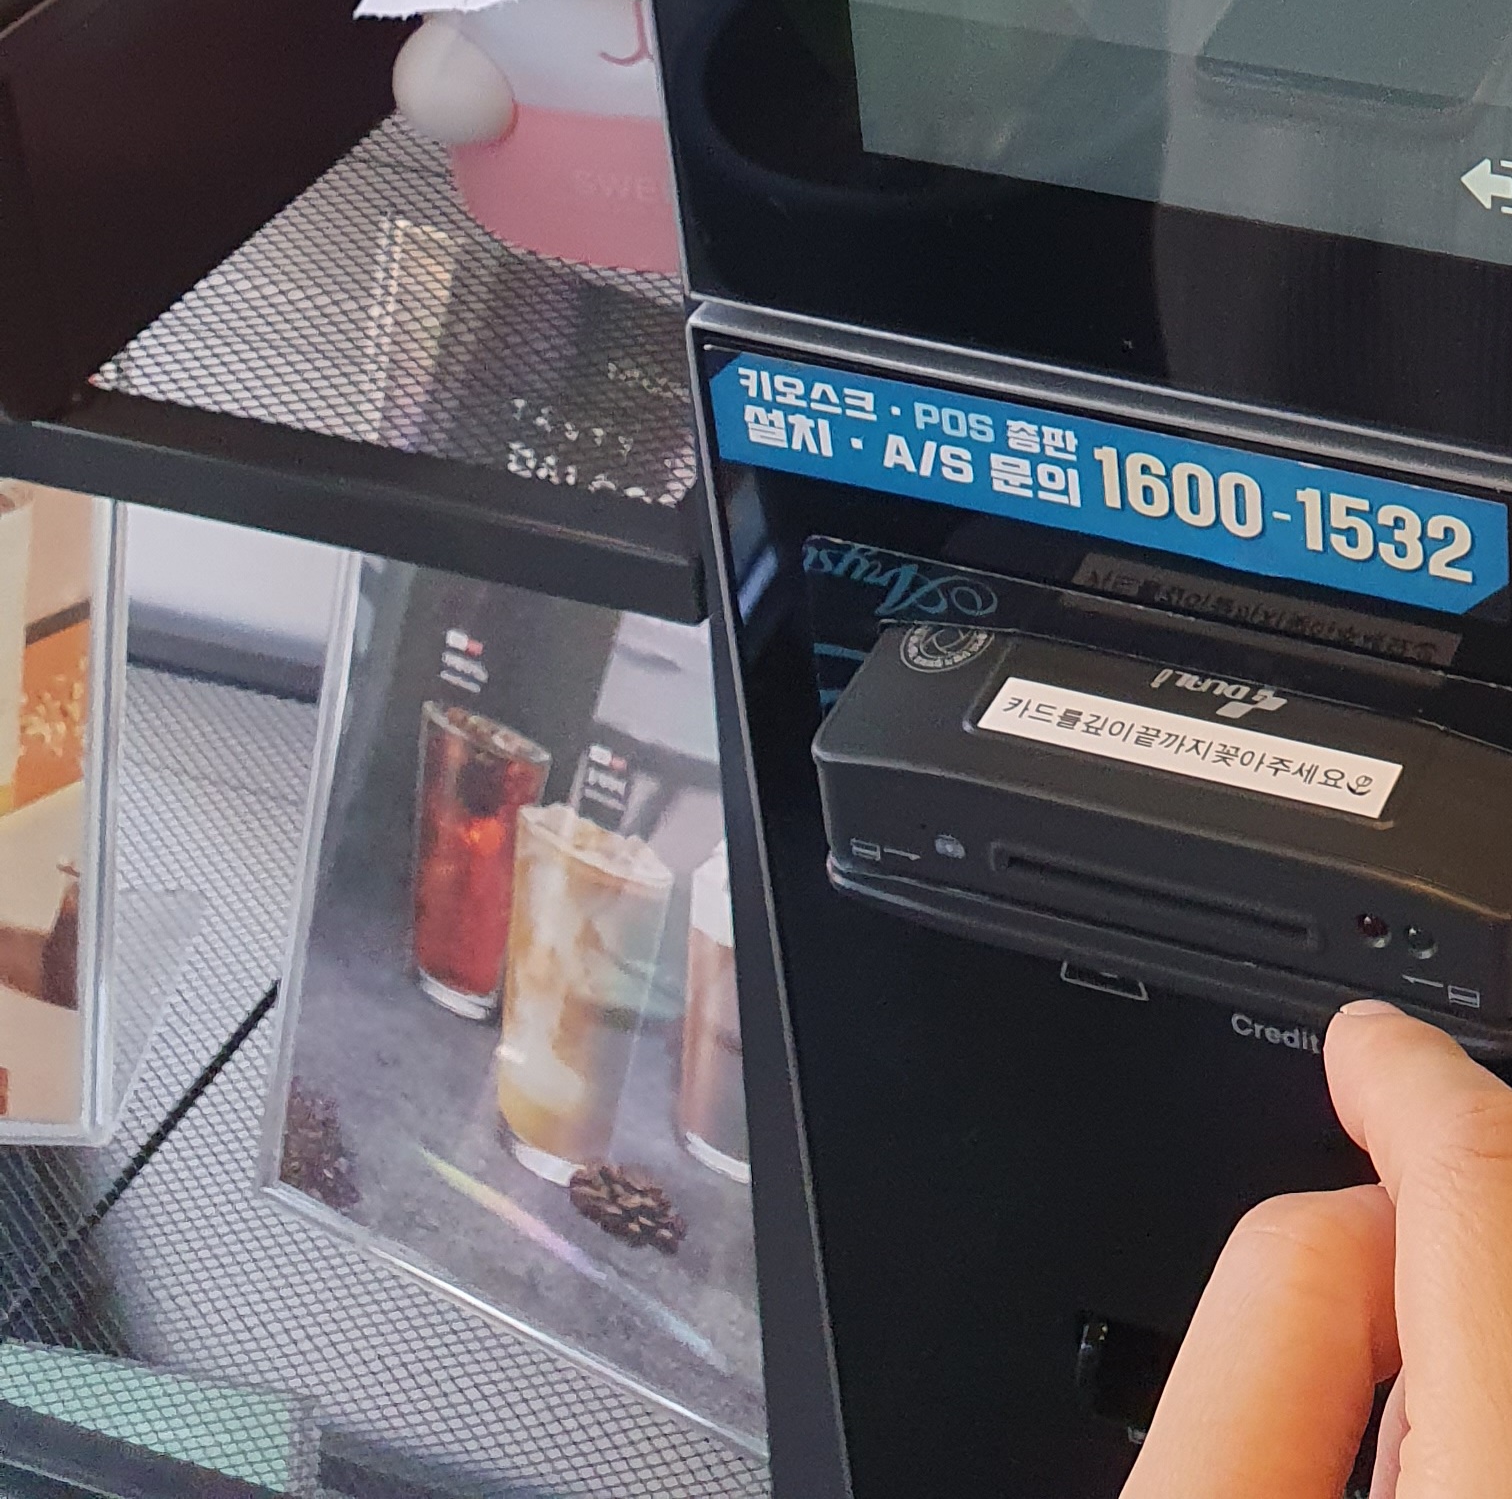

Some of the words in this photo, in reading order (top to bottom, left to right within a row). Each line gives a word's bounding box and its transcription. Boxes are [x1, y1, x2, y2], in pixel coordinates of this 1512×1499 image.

[738, 367, 877, 421] 키오스크
[914, 401, 995, 443] POS
[1006, 419, 1077, 462] 총판
[744, 404, 833, 458] 설치
[884, 433, 974, 483] A/S
[990, 452, 1081, 508] 문의
[1092, 444, 1476, 584] 1600-1532
[1231, 1013, 1320, 1054] Credit
